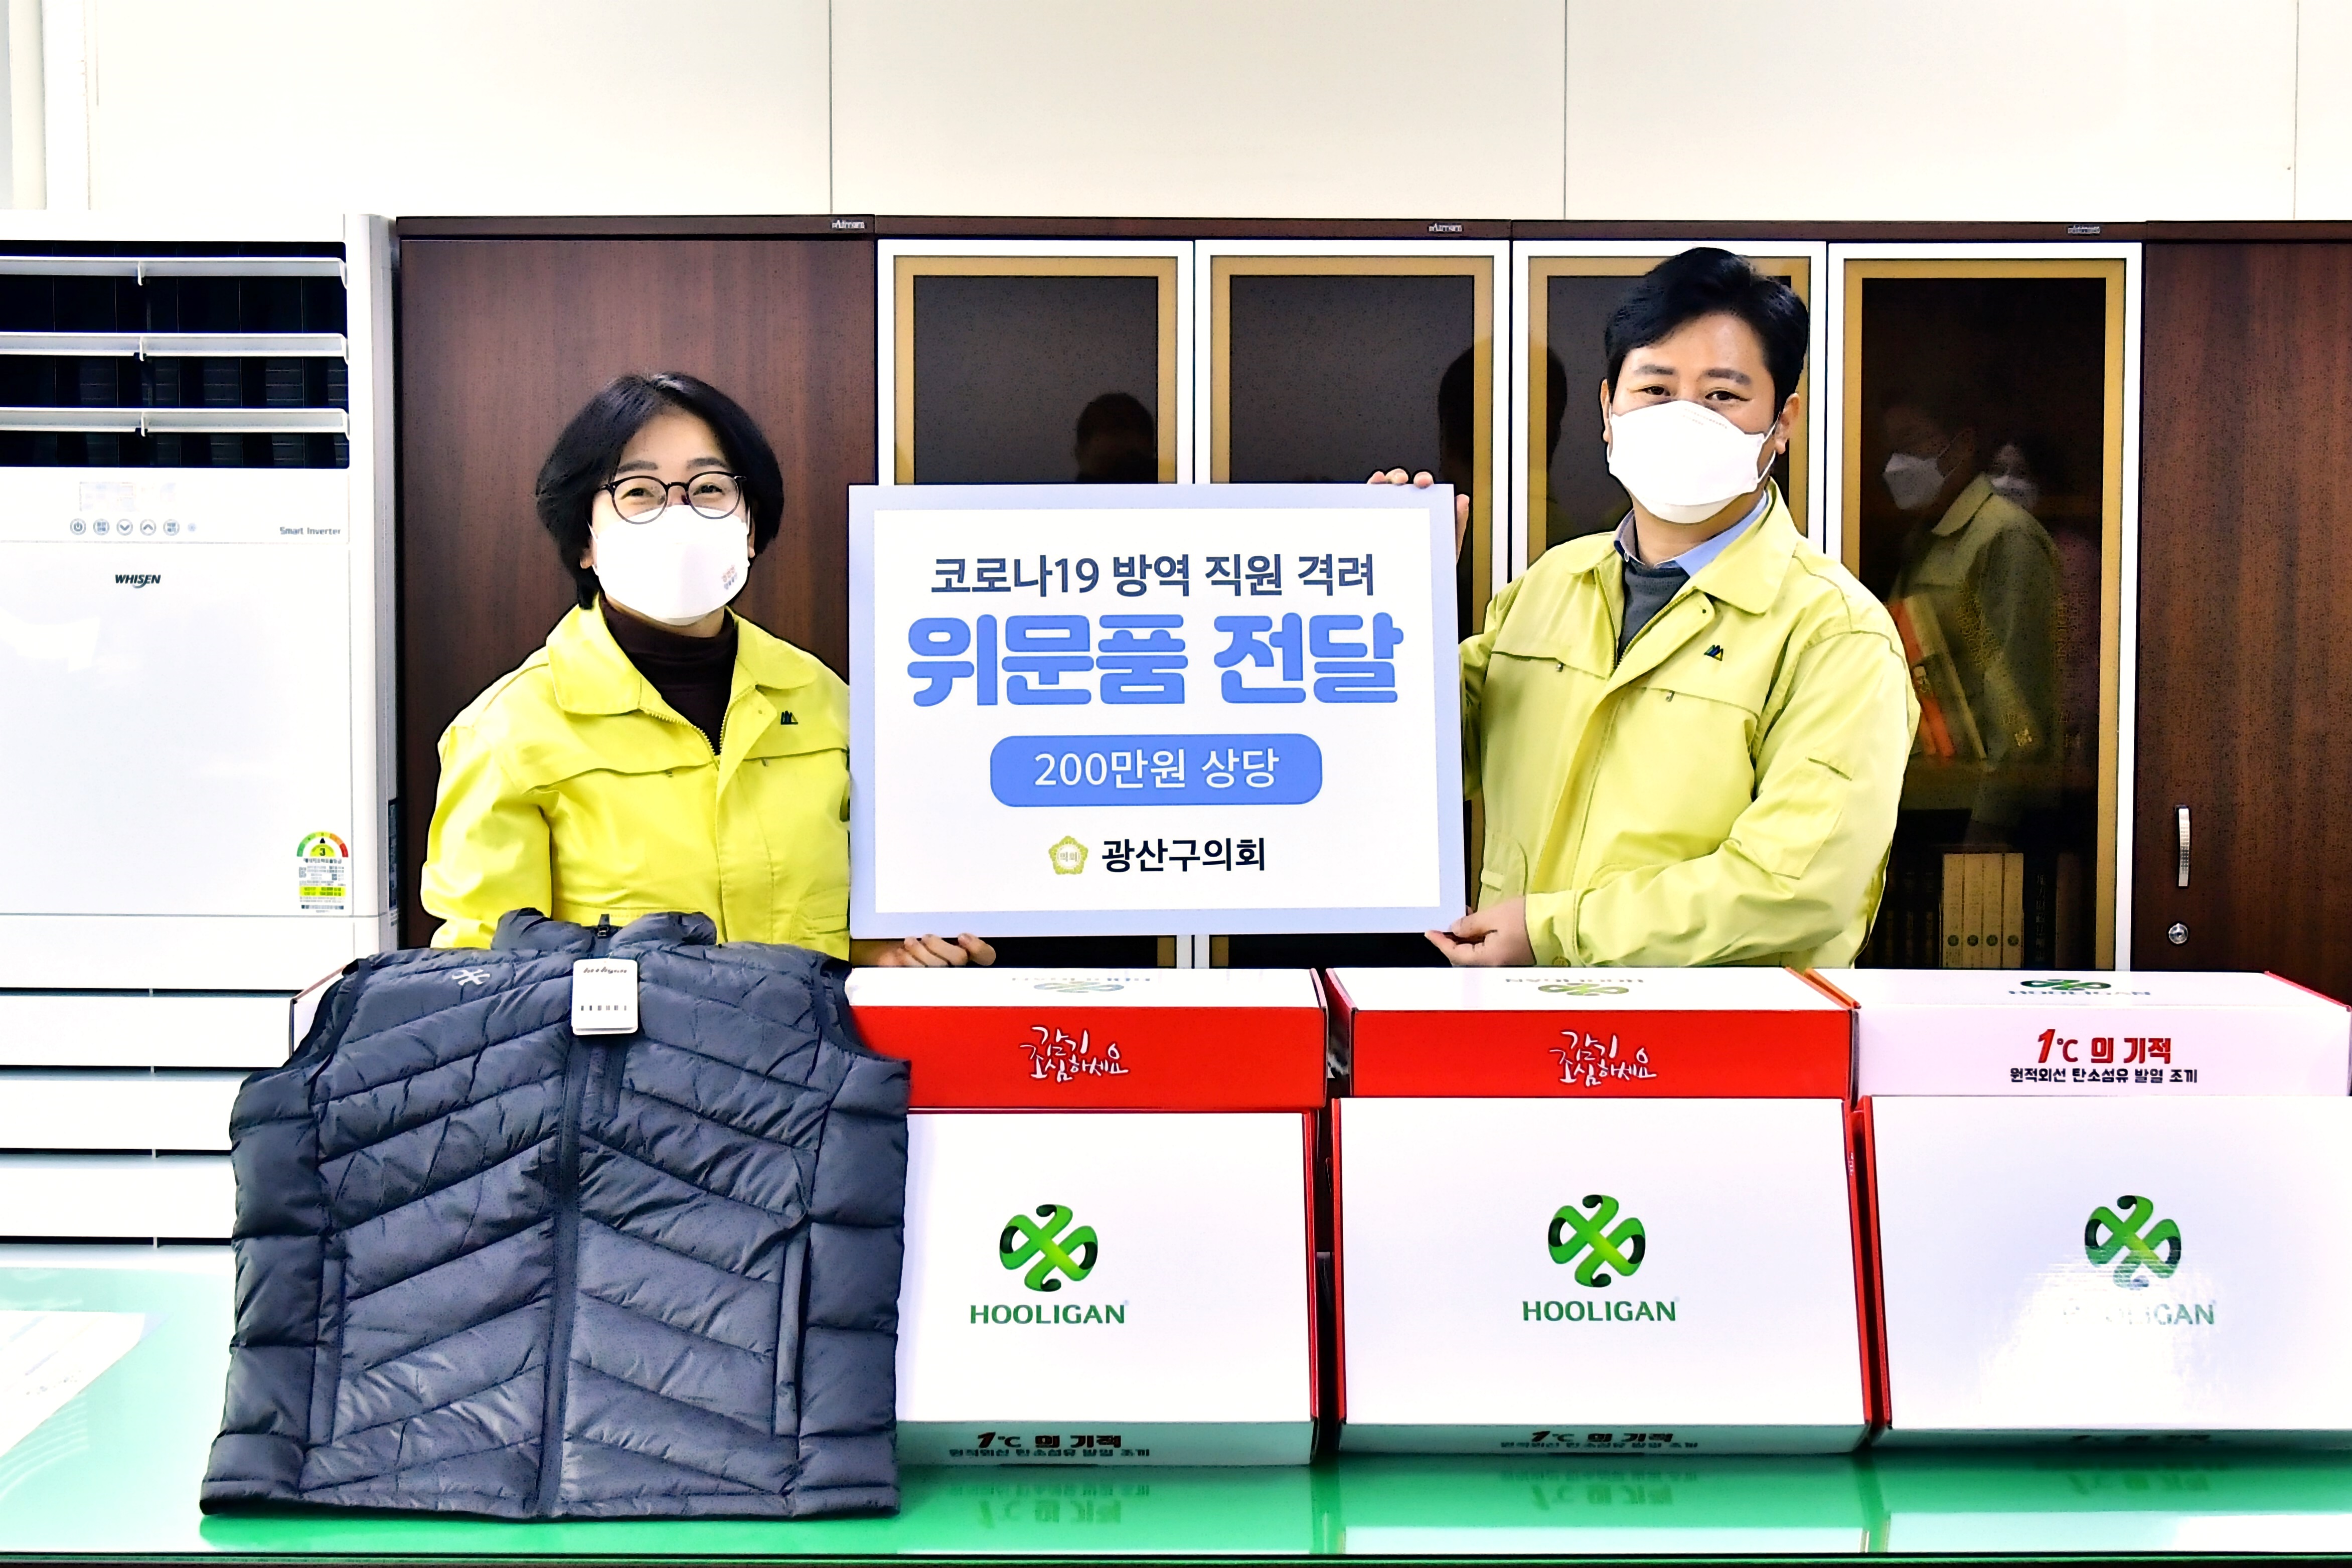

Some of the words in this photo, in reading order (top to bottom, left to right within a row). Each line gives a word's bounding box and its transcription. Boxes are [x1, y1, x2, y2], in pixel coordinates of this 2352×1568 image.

[280, 527, 303, 535] Smart
[115, 574, 161, 588] WHISEN
[931, 554, 1099, 597] 코로나19
[1113, 554, 1190, 597] 방역
[1205, 553, 1283, 596] 직원
[1298, 553, 1374, 596] 격려
[907, 613, 1189, 707] 위문품
[1213, 612, 1404, 704] 전달
[1034, 749, 1186, 789] 200만원
[1202, 748, 1280, 788] 상당
[1102, 837, 1265, 872] 광산구의회
[1031, 1026, 1089, 1057] 감기
[1560, 1031, 1618, 1061] 감기
[2091, 1037, 2114, 1064] 의
[2123, 1037, 2171, 1064] 기적
[1019, 1043, 1130, 1083] 조심하세요
[1548, 1047, 1657, 1087] 조심하세요
[2010, 1067, 2066, 1083] 원적외선
[2072, 1068, 2129, 1083] 탄소섬유
[2134, 1068, 2163, 1084] 발열
[2169, 1069, 2198, 1083] 조끼
[970, 1304, 1125, 1325] HOOLIGAN
[1522, 1300, 1676, 1322] HOOLIGAN
